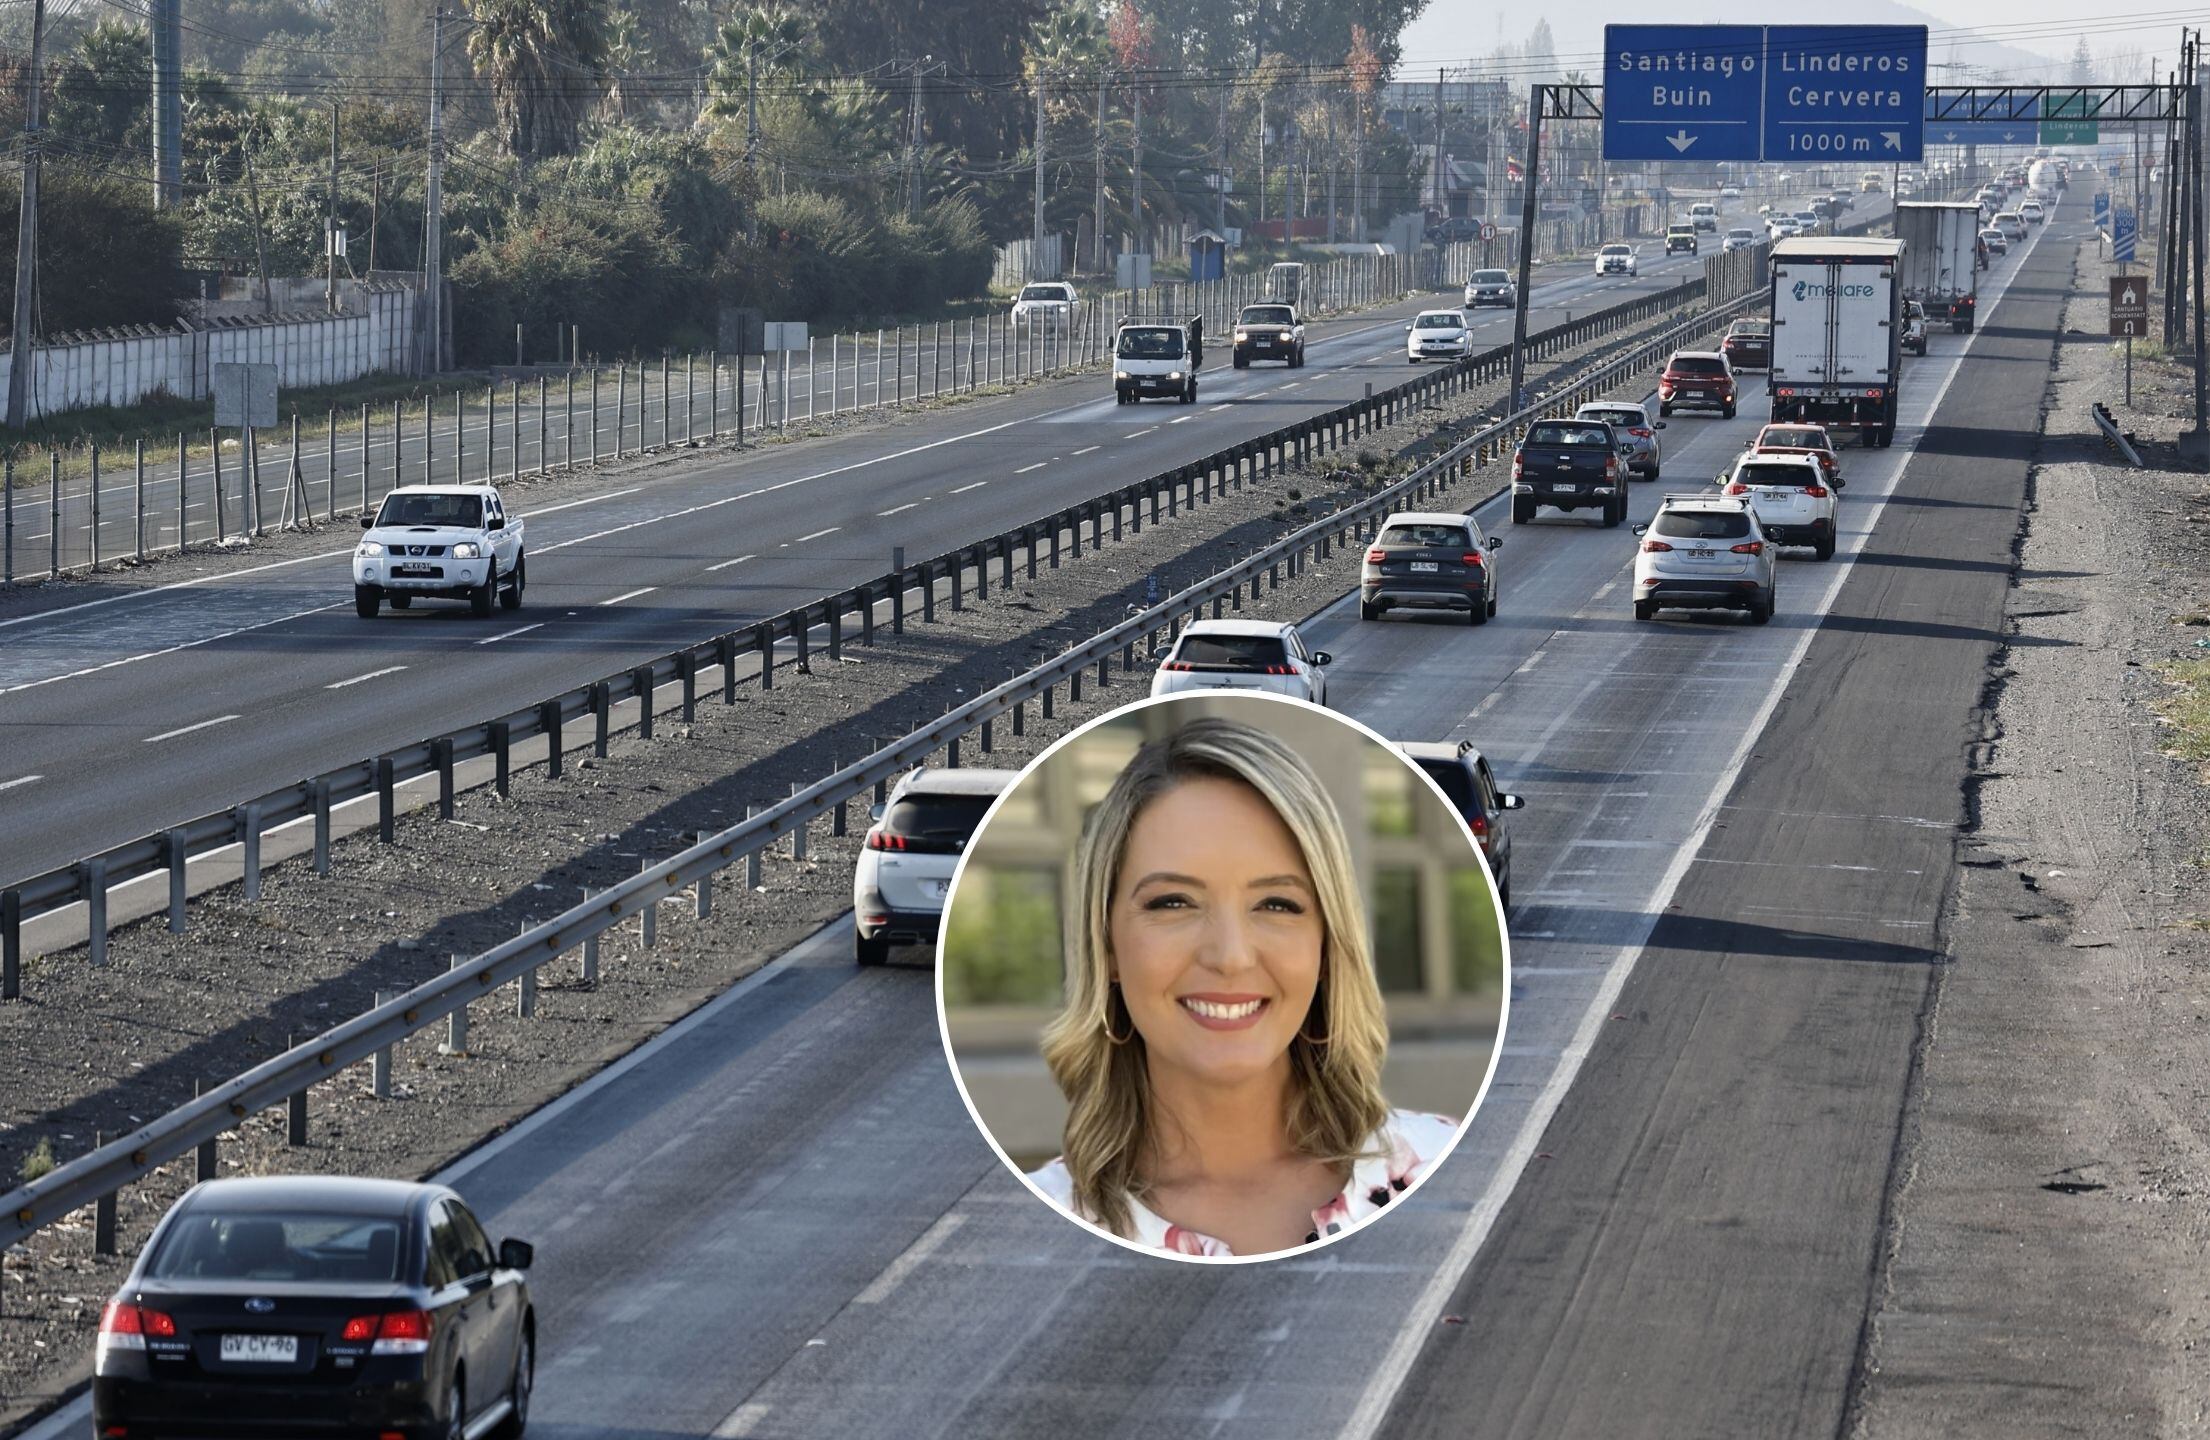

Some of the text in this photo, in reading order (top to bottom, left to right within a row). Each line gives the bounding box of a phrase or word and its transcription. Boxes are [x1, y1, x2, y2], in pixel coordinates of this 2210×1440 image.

[1619, 52, 1755, 78] Santiago
[1782, 52, 1909, 72] Linderos
[1653, 86, 1711, 106] Buin
[1789, 86, 1901, 106] Cervera
[1789, 134, 1870, 151] 1000 m
[223, 1335, 242, 1352] GV
